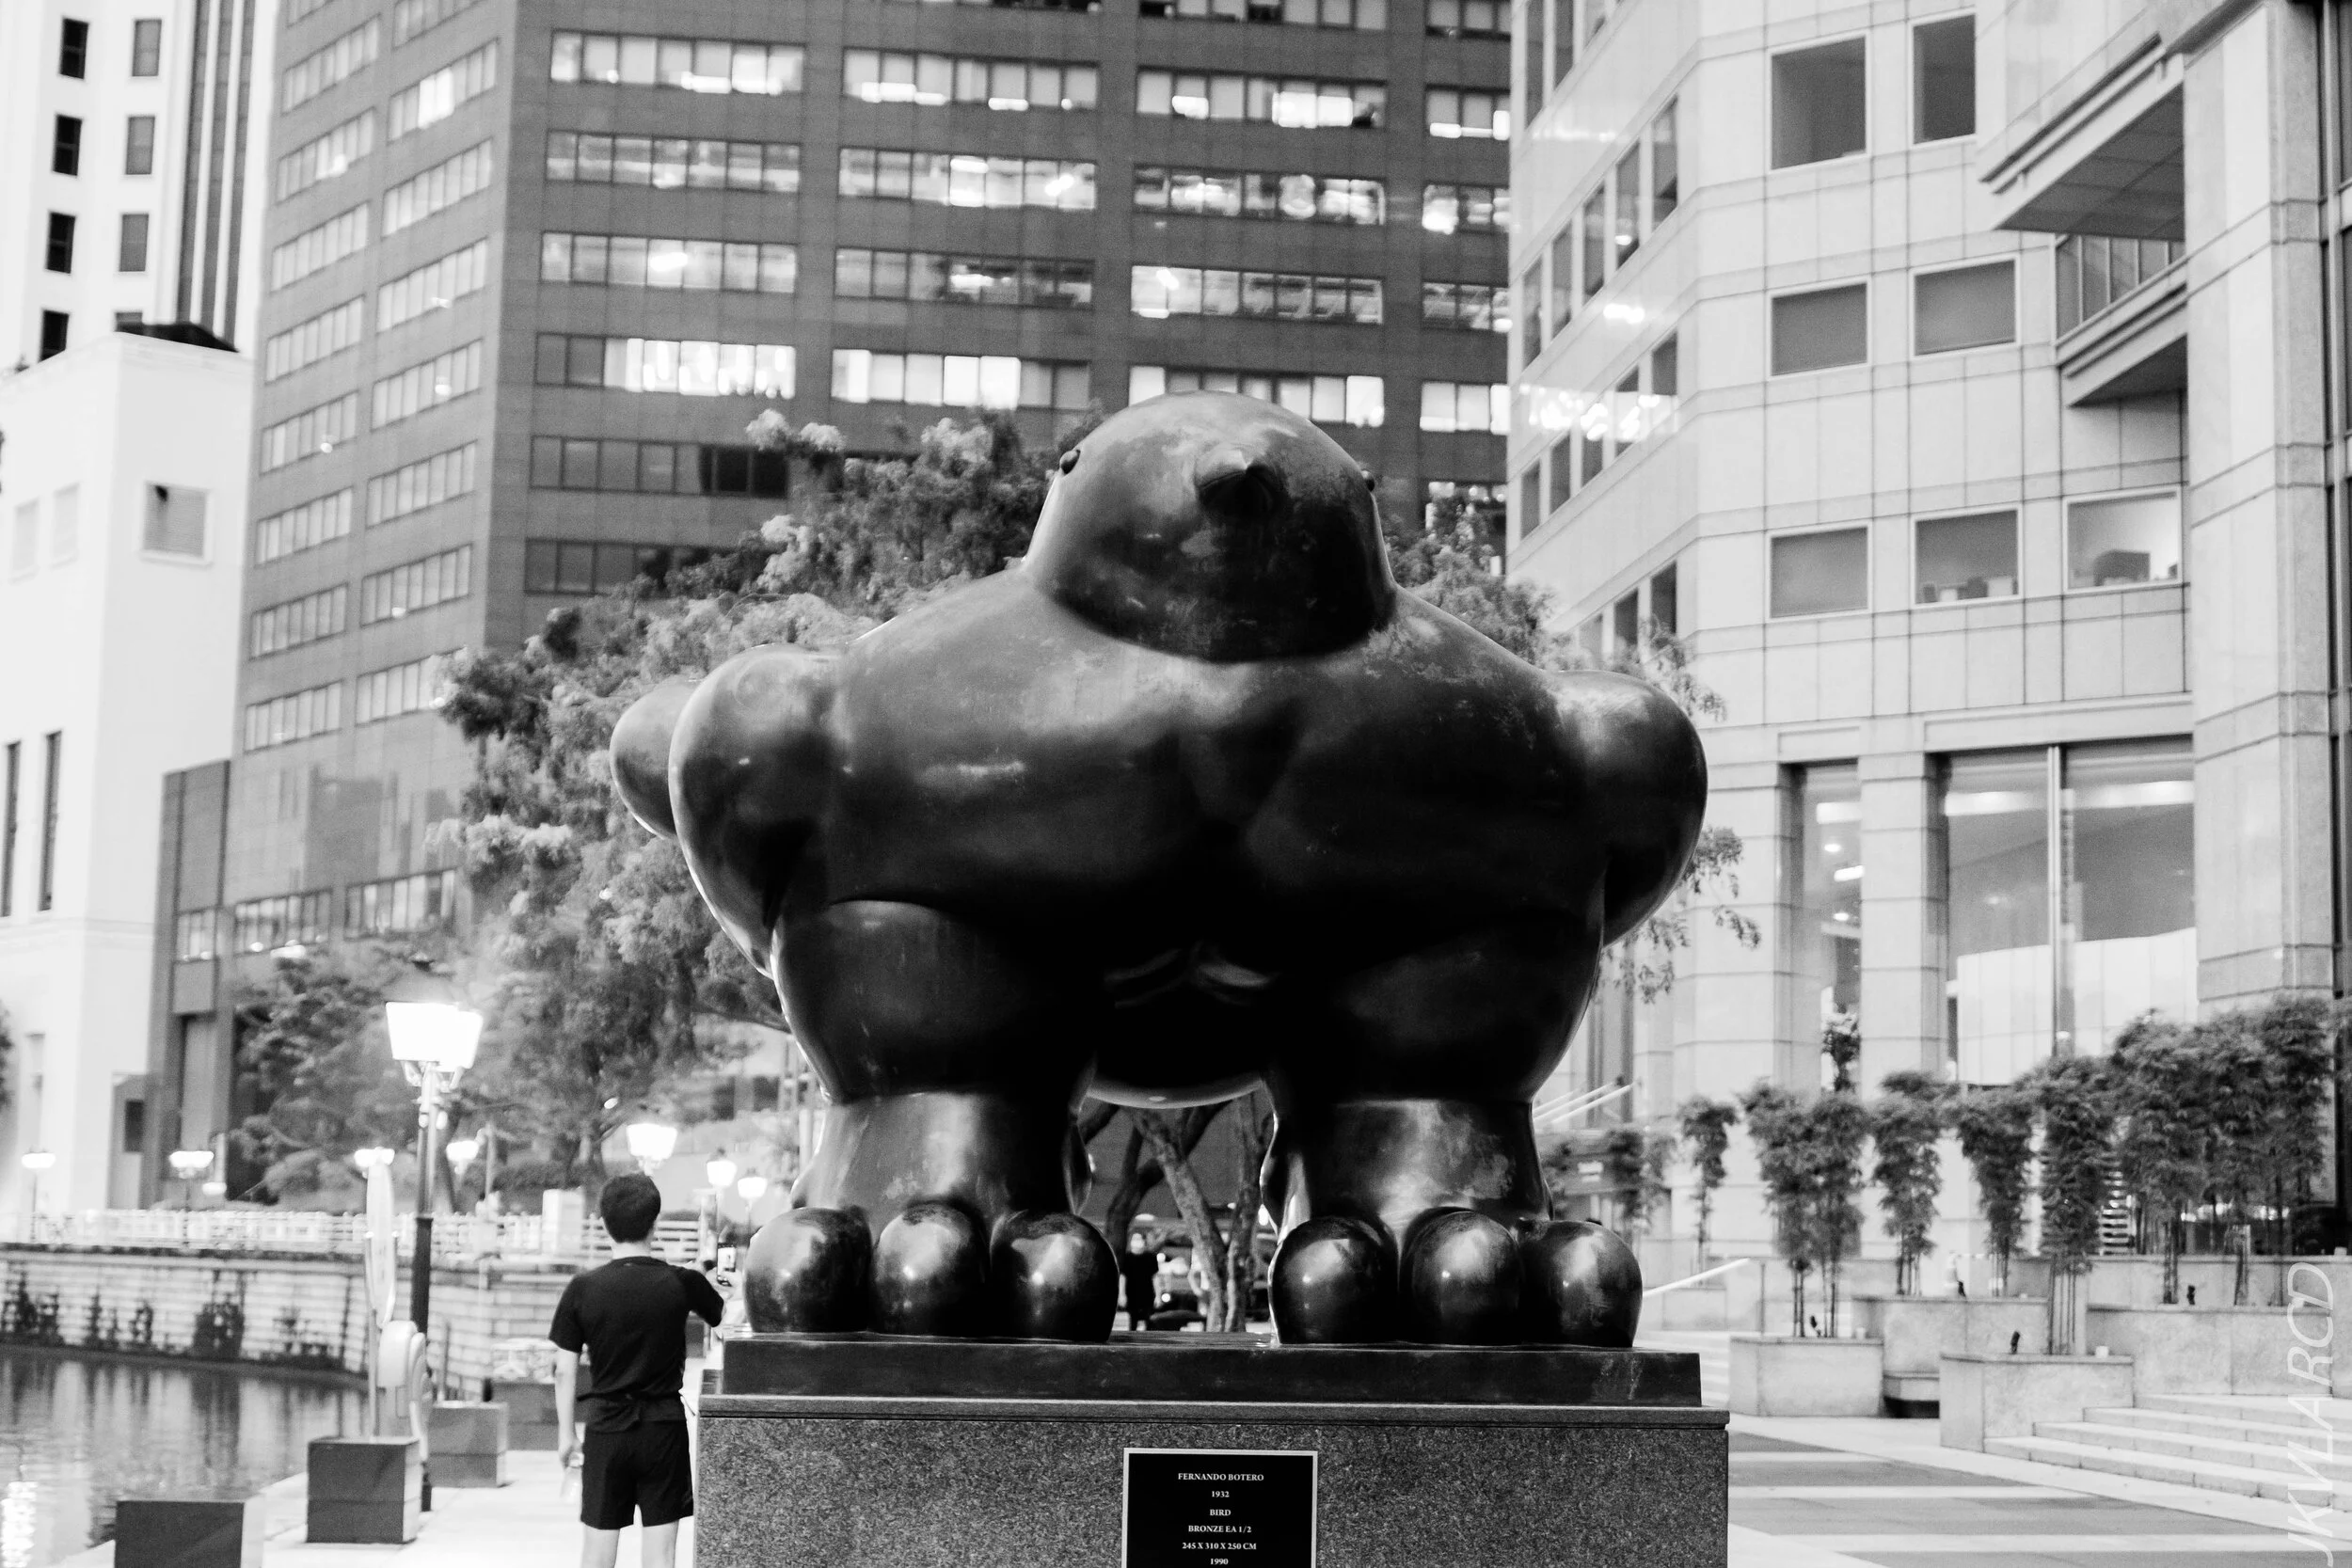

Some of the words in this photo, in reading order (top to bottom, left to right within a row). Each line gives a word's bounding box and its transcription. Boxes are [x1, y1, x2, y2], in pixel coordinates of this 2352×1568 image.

[1178, 1472, 1227, 1481] FERNANDO
[1228, 1473, 1264, 1481] BOTERO
[1211, 1490, 1230, 1498] 1932
[1188, 1525, 1224, 1533] BRONZE
[1225, 1525, 1237, 1533] EA
[1205, 1542, 1219, 1550] 310
[1242, 1542, 1257, 1550] CM
